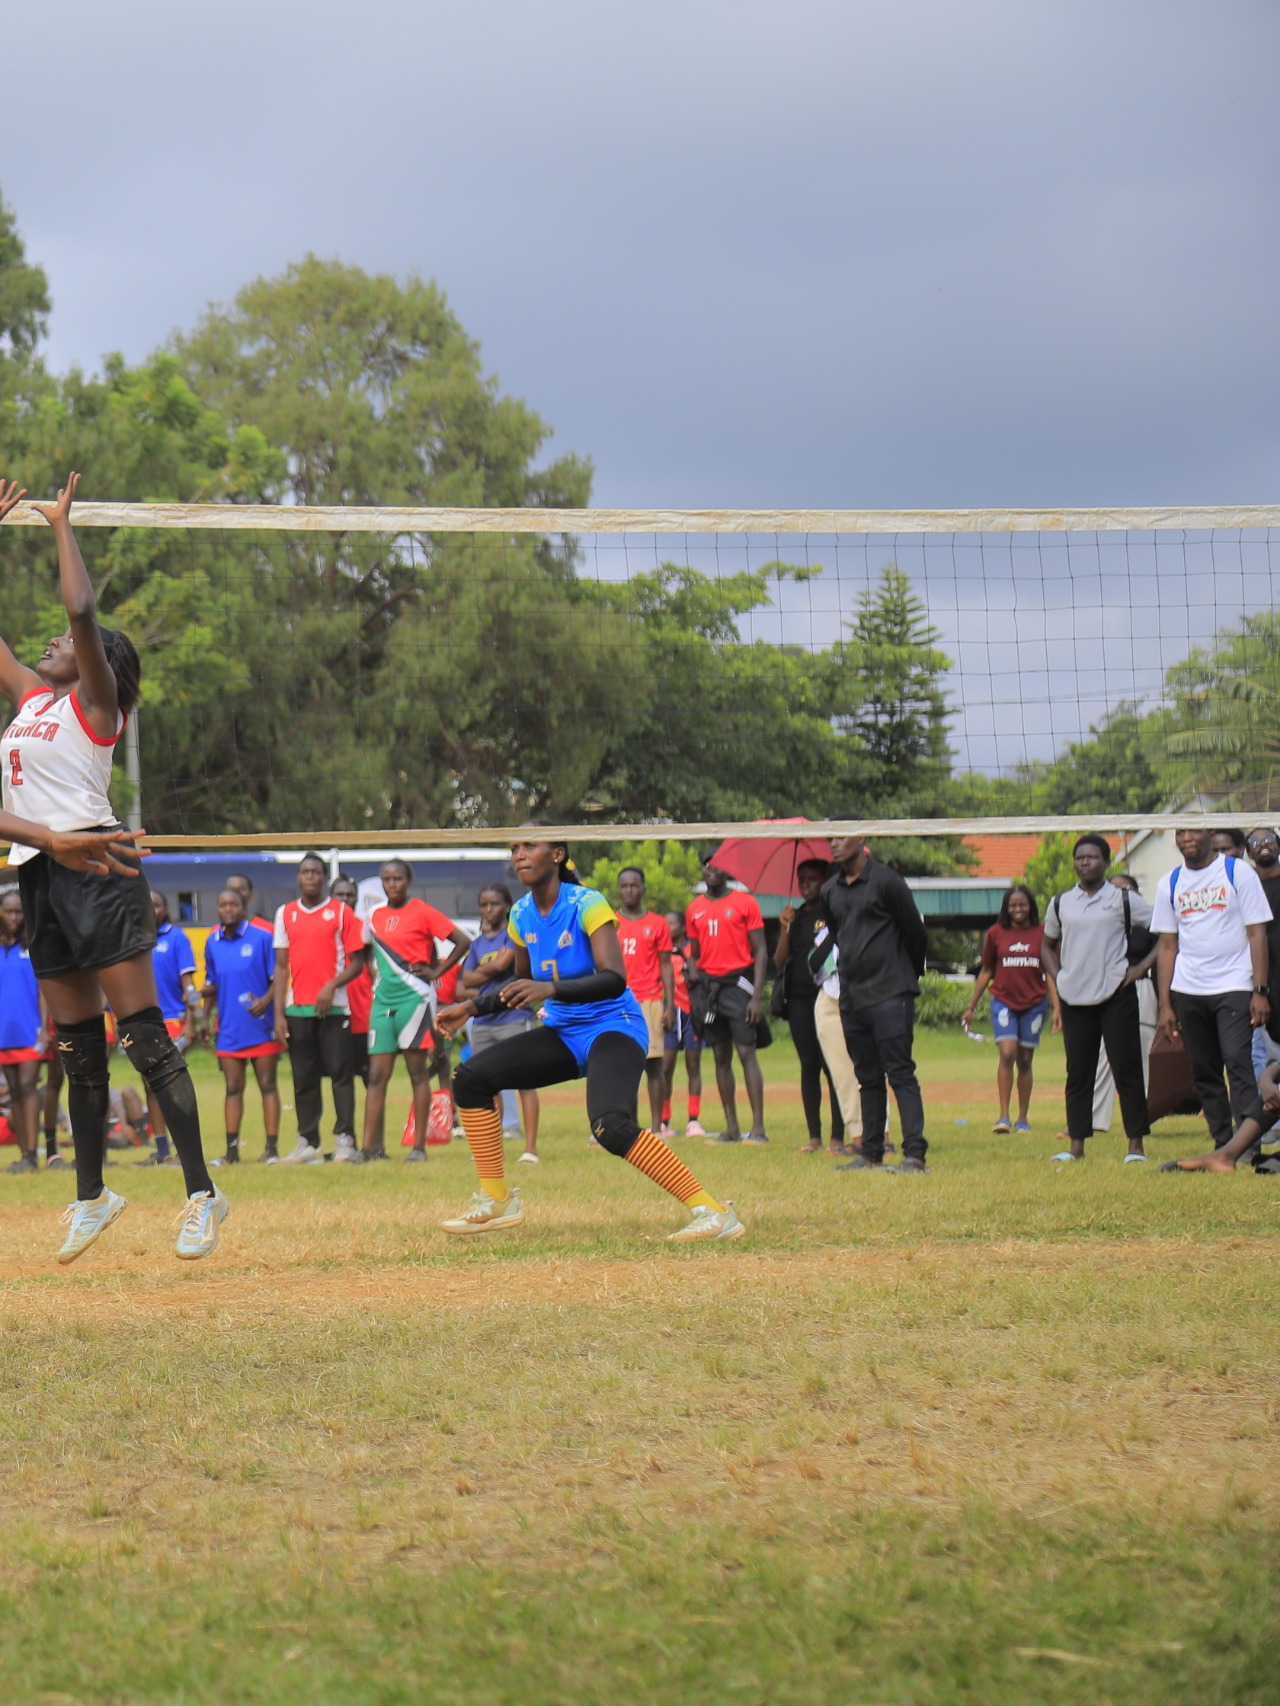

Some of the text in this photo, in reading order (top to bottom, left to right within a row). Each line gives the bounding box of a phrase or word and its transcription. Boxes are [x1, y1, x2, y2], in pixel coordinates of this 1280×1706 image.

[9, 749, 23, 786] 2
[386, 916, 400, 931] 17
[708, 919, 718, 936] 11
[623, 938, 637, 955] 12
[542, 959, 560, 982] 7
